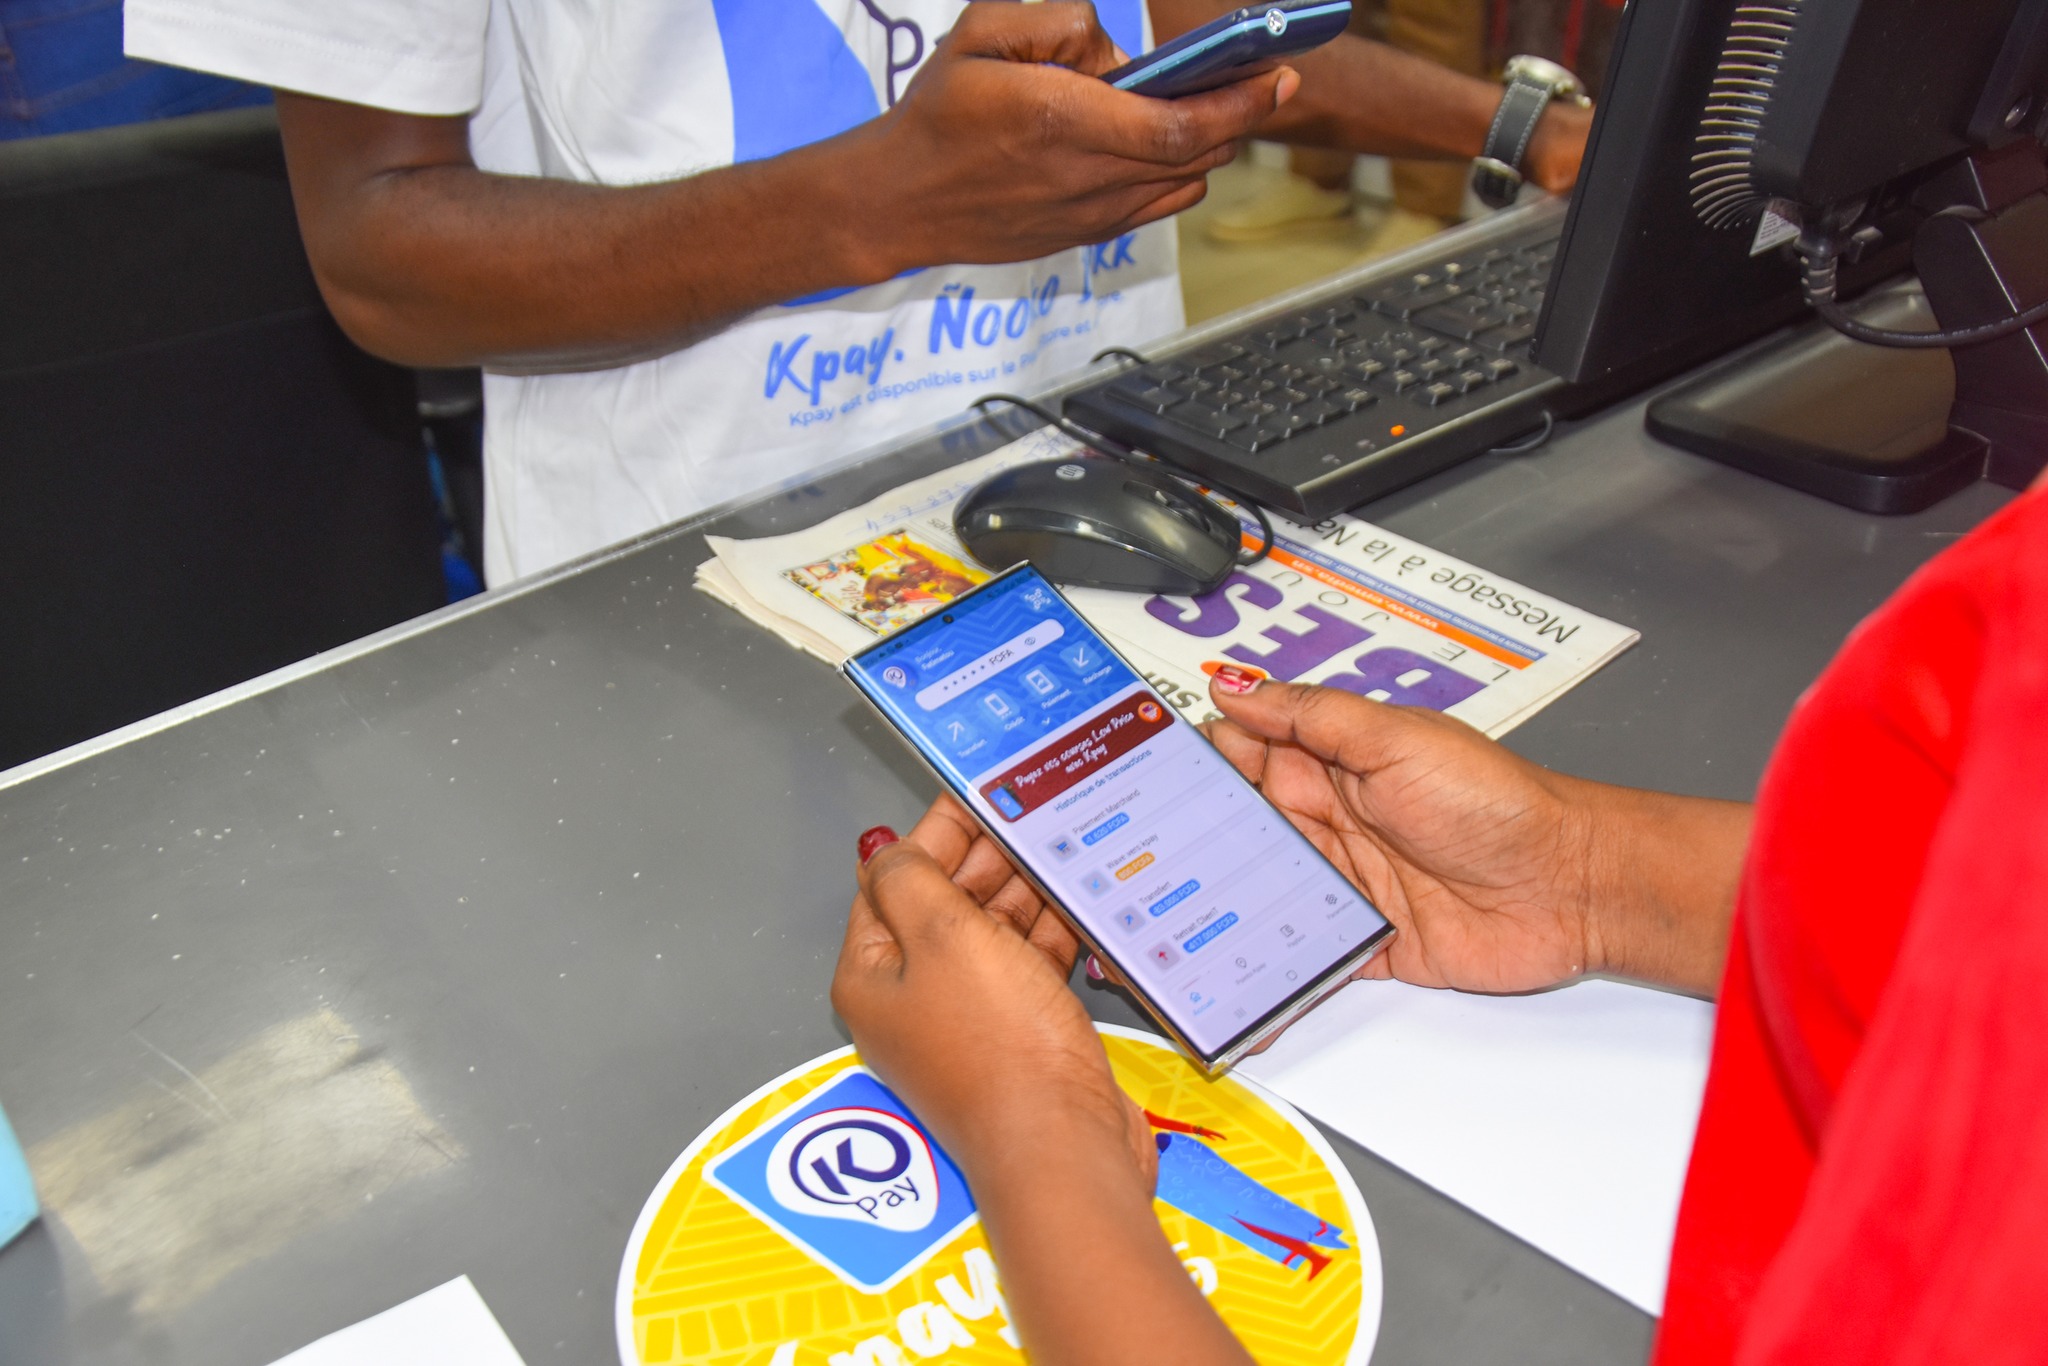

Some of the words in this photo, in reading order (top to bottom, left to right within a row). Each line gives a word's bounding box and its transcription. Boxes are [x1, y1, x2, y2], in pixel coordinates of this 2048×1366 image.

[764, 327, 904, 406] Kpay.
[789, 404, 836, 428] Kpay
[865, 367, 964, 403] disponible
[1362, 538, 1397, 563] la
[1400, 554, 1428, 576] à
[1291, 562, 1437, 626] www.emedia.sn
[1429, 566, 1581, 644] Message
[989, 648, 1014, 665] FCFA
[1432, 641, 1511, 681] LE
[1053, 784, 1095, 811] Historique
[1094, 776, 1107, 787] de
[1105, 749, 1152, 778] transactions
[1105, 854, 1127, 869] Wave
[1125, 843, 1142, 857] vers
[854, 1176, 920, 1220] Pay
